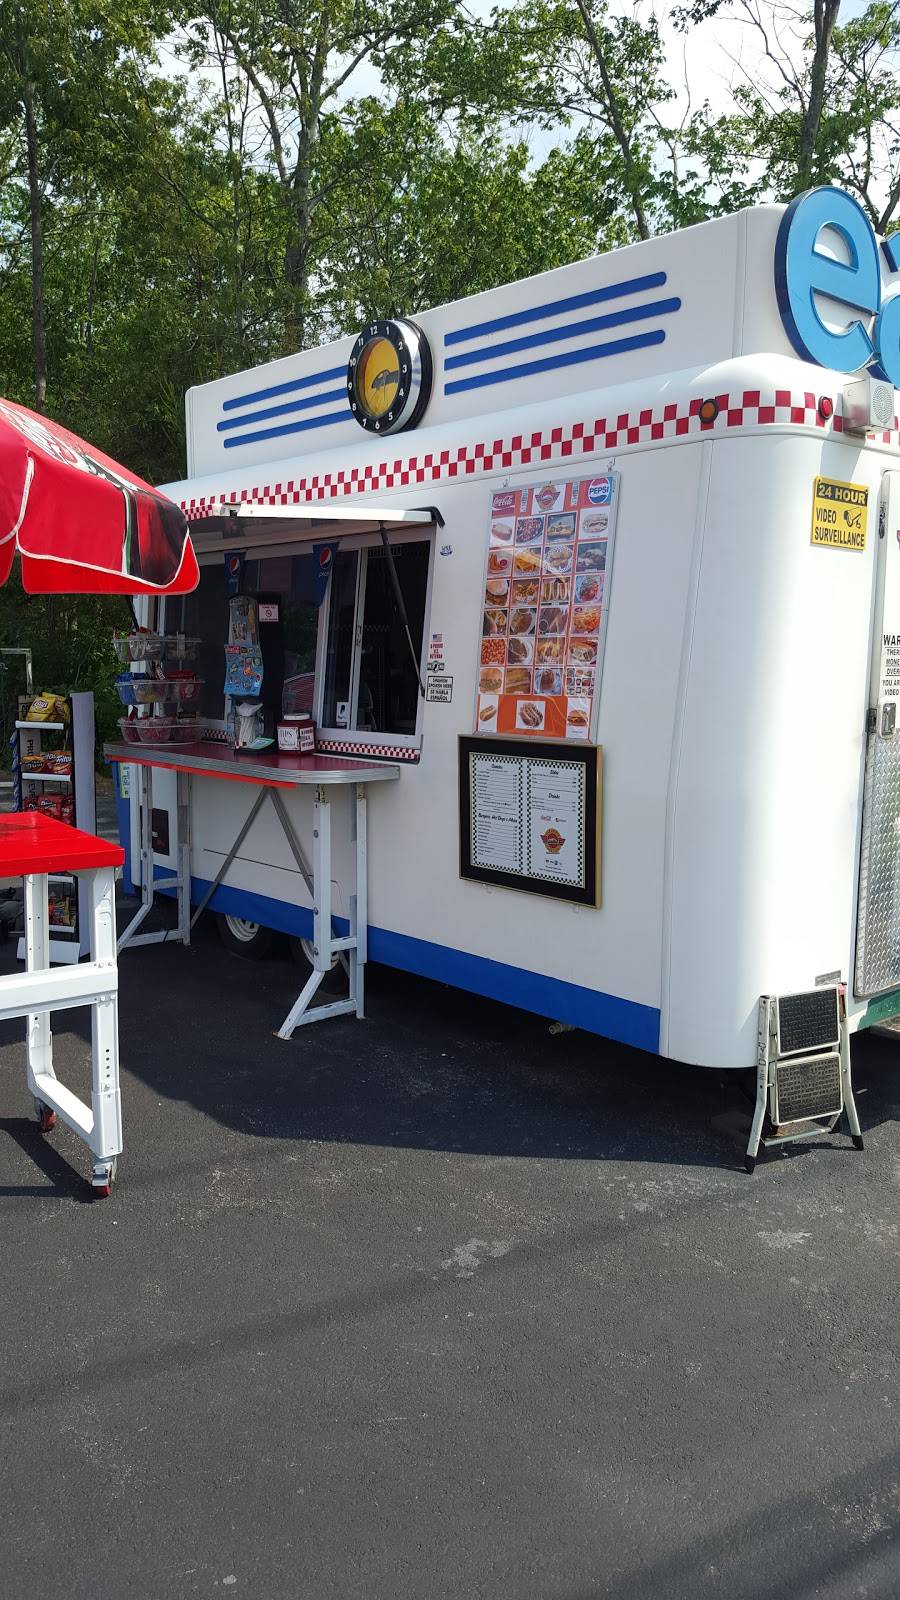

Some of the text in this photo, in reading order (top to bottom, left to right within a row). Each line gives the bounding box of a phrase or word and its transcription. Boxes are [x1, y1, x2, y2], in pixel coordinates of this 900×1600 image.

[370, 326, 378, 335] 12
[385, 326, 390, 335] 1
[357, 337, 364, 346] 11
[398, 341, 404, 350] 2
[350, 358, 357, 367] 10
[402, 364, 407, 373] 3
[347, 382, 353, 390] 9
[398, 388, 404, 397] 4
[351, 402, 357, 411] 8
[388, 412, 393, 421] 5
[362, 418, 367, 427] 7
[375, 420, 380, 429] 6
[589, 483, 609, 495] PEPSI
[818, 484, 866, 505] 24 HOUR
[815, 507, 837, 525] VIDEO
[814, 526, 865, 548] SURVEILLANCE
[884, 688, 900, 696] VIDEO
